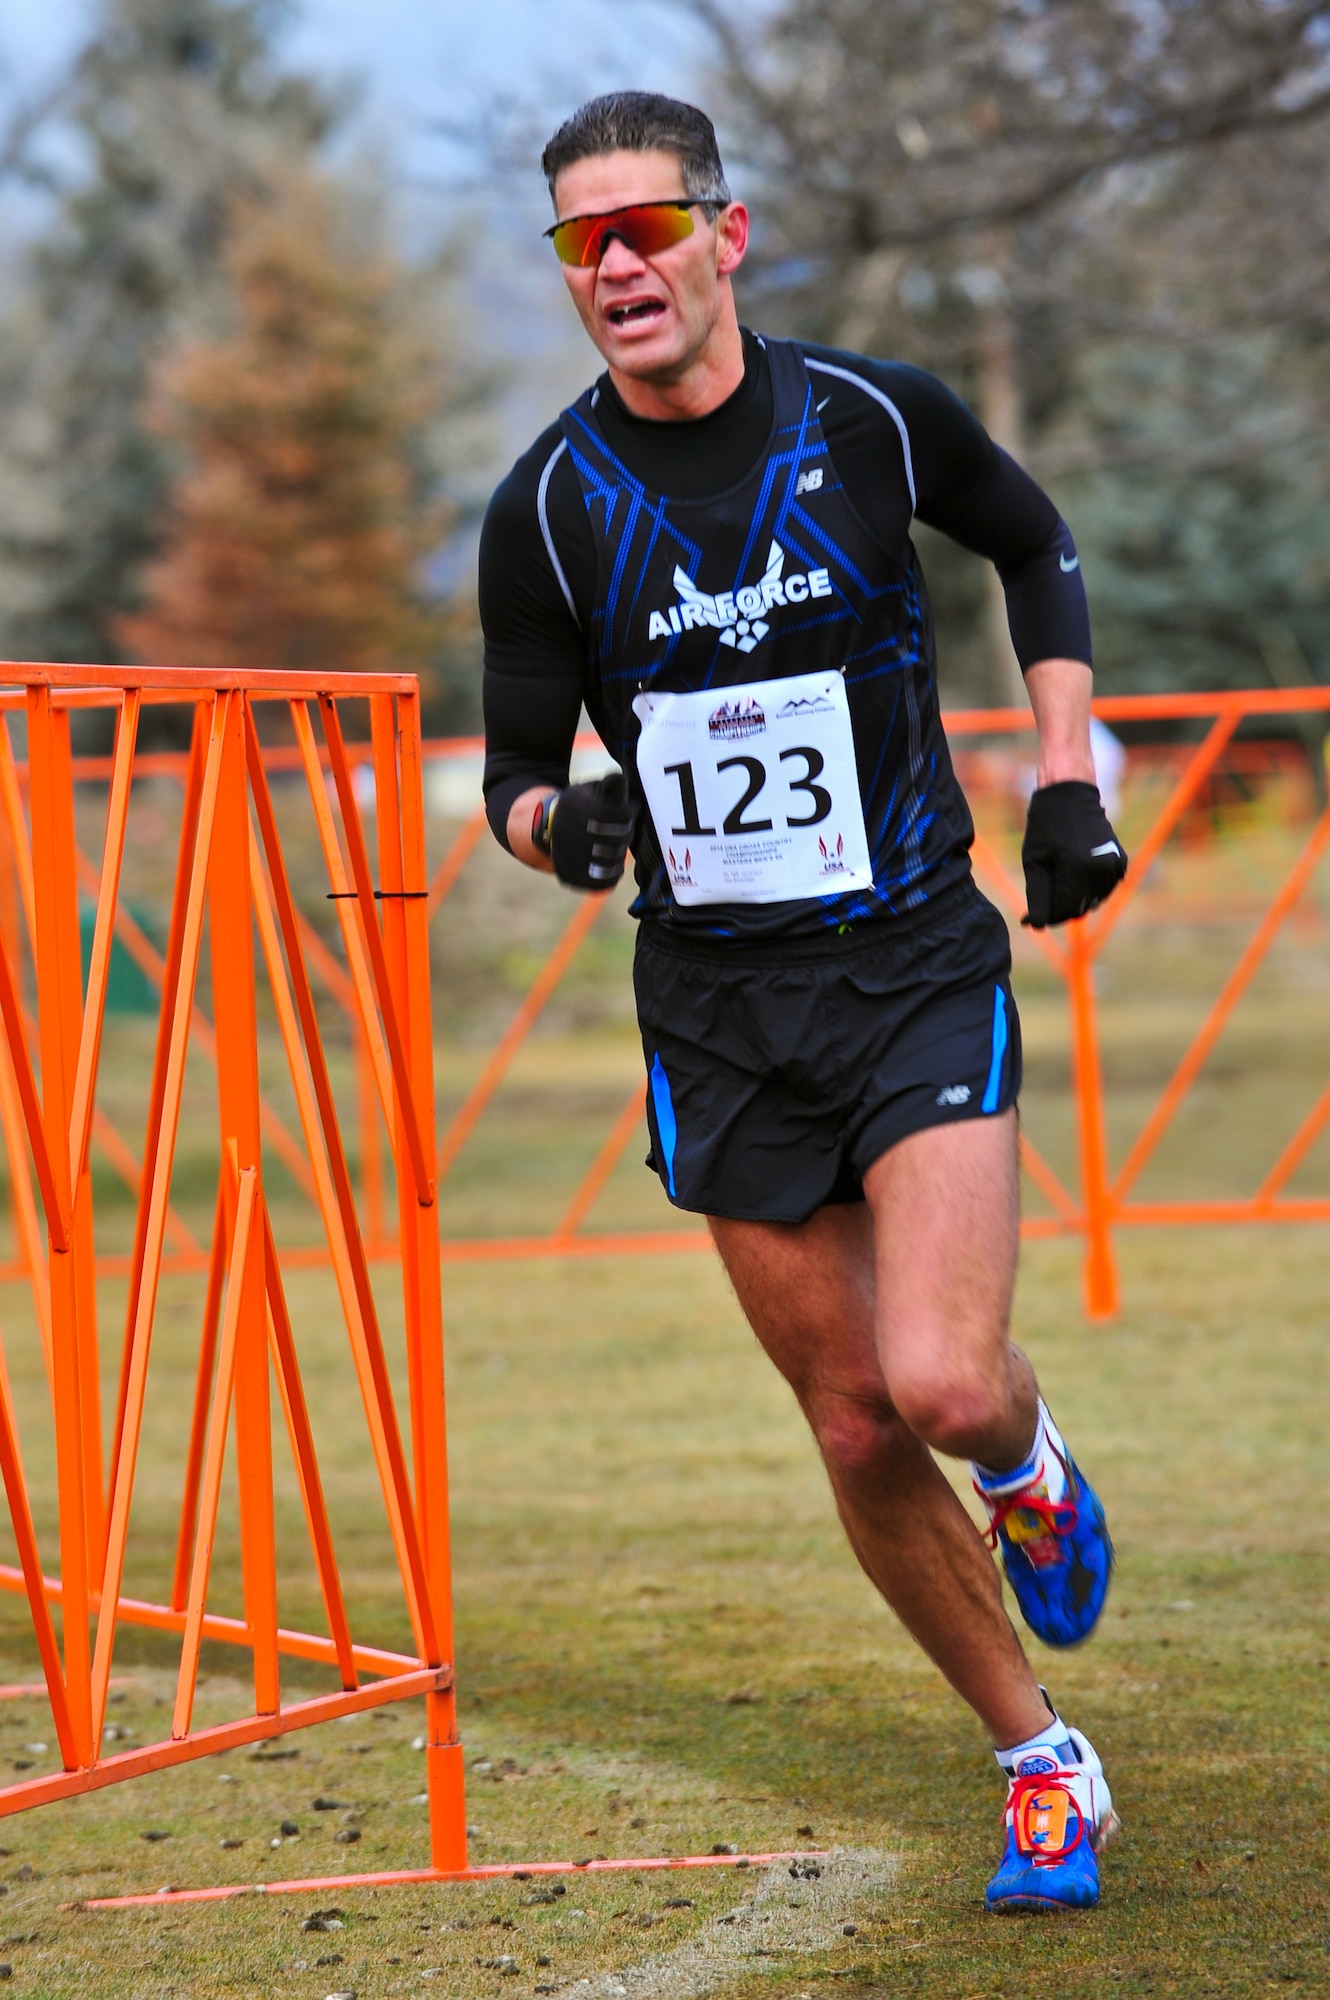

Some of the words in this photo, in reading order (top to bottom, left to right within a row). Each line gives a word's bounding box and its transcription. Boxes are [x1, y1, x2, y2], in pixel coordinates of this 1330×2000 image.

[648, 605, 710, 641] AIR
[713, 567, 833, 622] FORCE
[663, 746, 832, 837] 123
[673, 874, 692, 883] USA
[824, 861, 844, 872] USA
